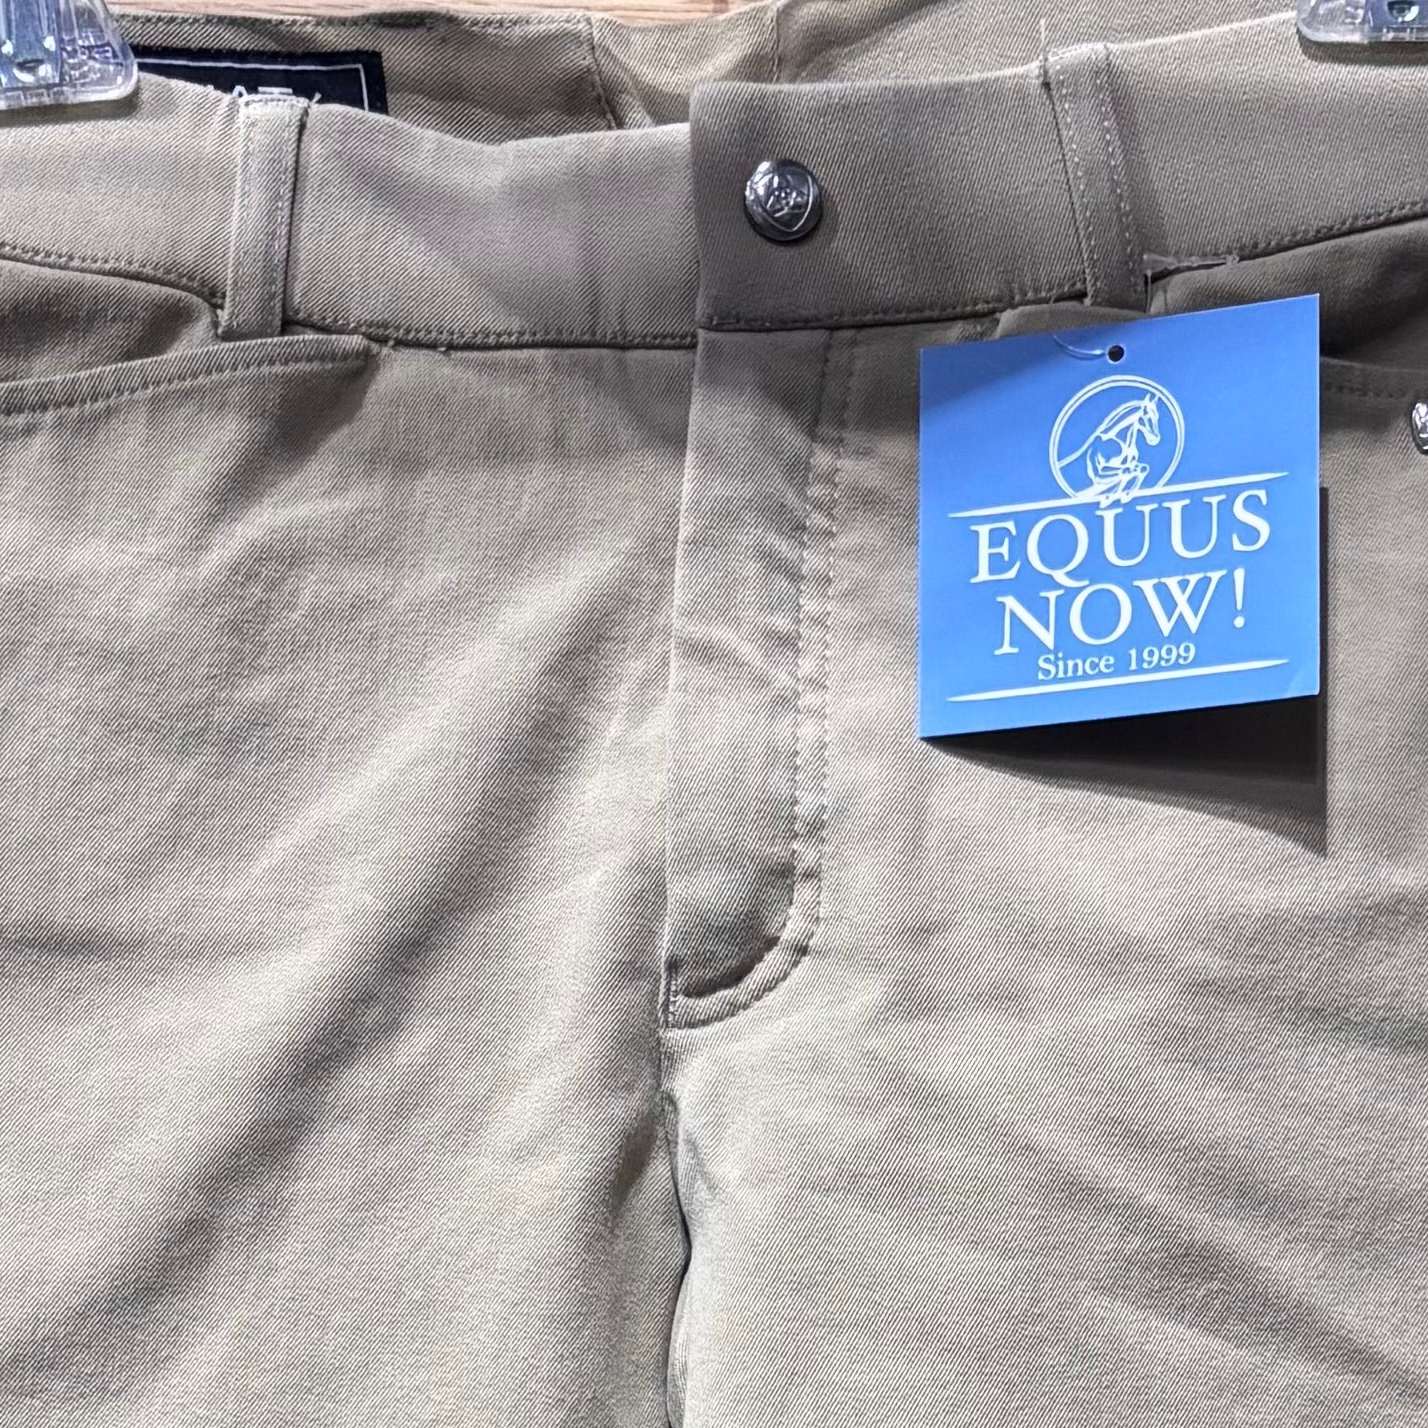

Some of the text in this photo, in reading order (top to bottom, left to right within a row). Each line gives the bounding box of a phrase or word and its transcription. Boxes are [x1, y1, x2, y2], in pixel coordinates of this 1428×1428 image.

[969, 488, 1271, 588] EQUUS
[993, 567, 1246, 656] NOW!
[1037, 642, 1197, 681] Since 1999
